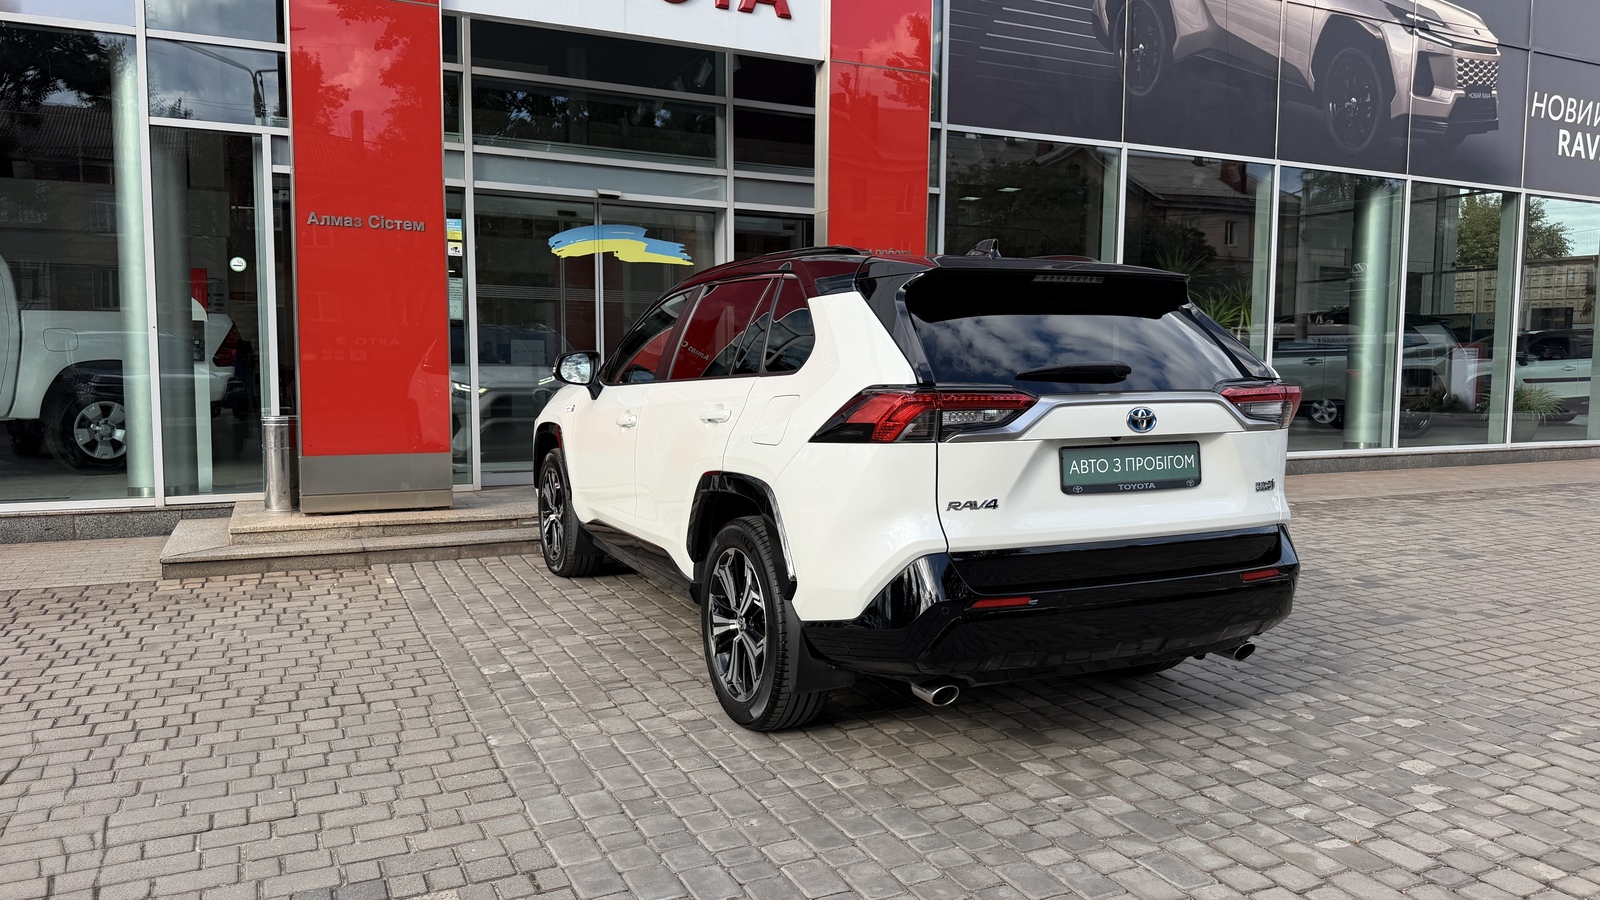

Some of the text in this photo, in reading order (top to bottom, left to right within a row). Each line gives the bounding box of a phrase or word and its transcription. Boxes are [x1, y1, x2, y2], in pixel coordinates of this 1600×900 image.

[1557, 129, 1600, 161] RAV
[307, 211, 425, 232] Алмаз Сістем
[1069, 454, 1195, 475] АВТО З ПРОБІГОМ
[1117, 482, 1156, 491] TOYOTA
[945, 498, 999, 511] RAV4
